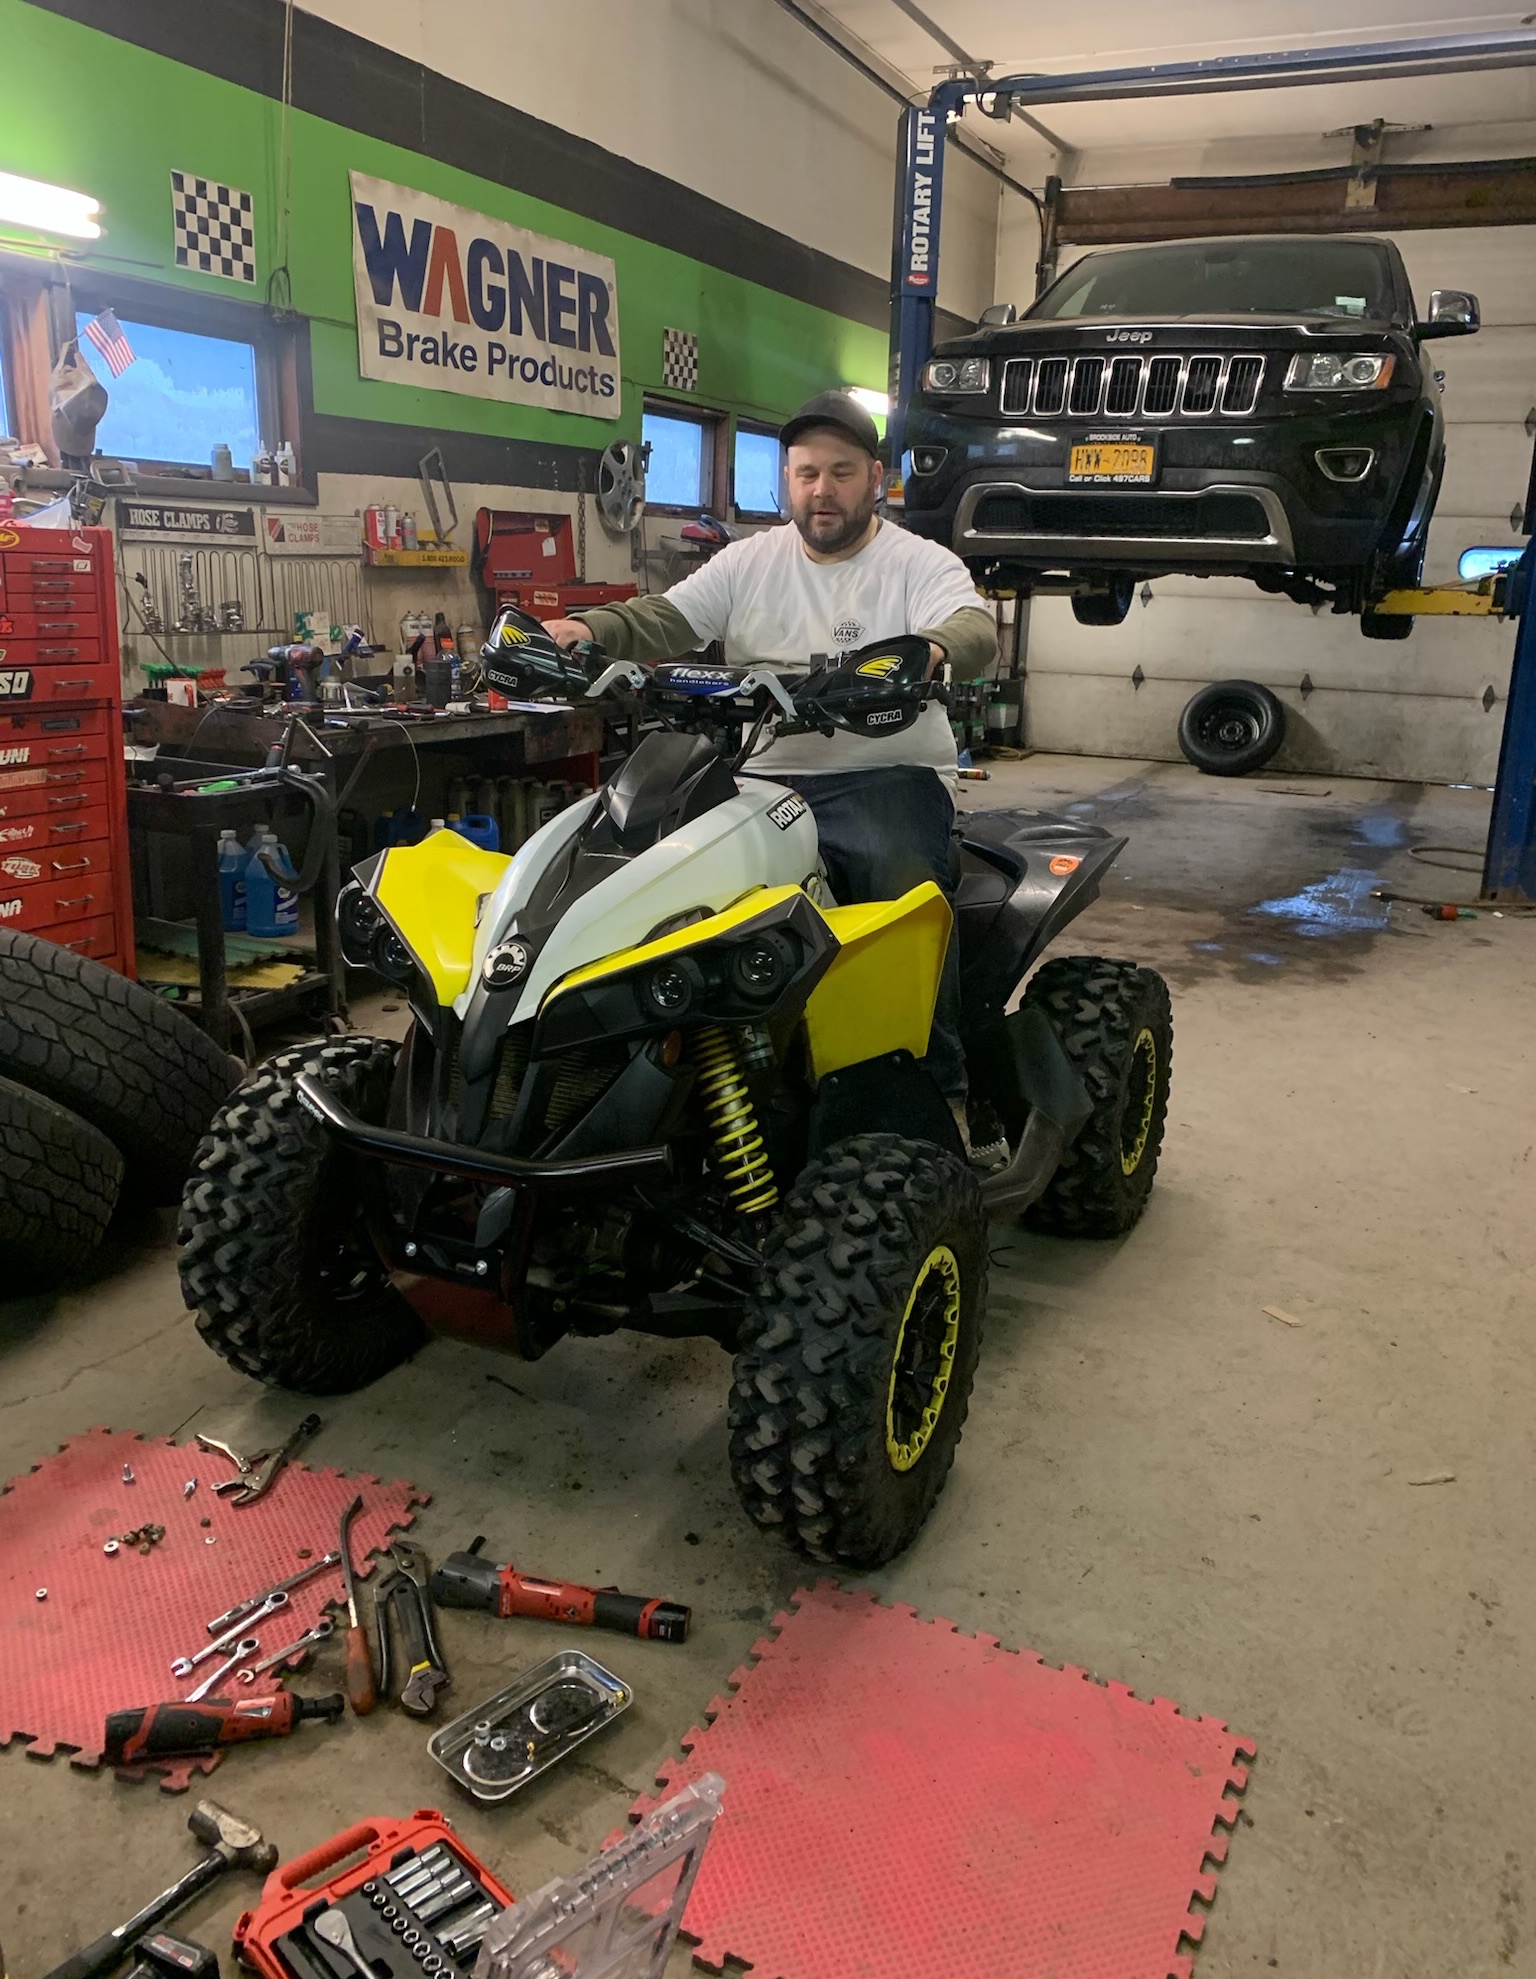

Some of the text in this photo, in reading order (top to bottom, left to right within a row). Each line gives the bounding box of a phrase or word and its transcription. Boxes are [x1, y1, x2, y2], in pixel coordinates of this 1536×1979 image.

[911, 111, 936, 271] ROTARY LIFT
[355, 202, 616, 357] WAGNER
[1106, 328, 1153, 344] Jeep
[377, 318, 615, 397] Brake Products
[1121, 433, 1138, 442] AUTO
[1069, 474, 1082, 482] Call
[1094, 474, 1111, 482] Click
[128, 508, 211, 530] HOSE CLAMPS
[296, 522, 319, 532] HOSE
[288, 532, 320, 543] CLAMPS
[833, 626, 860, 638] VANS
[488, 669, 518, 687] CYCRA
[867, 709, 902, 725] CYCRA
[496, 963, 522, 973] BRP
